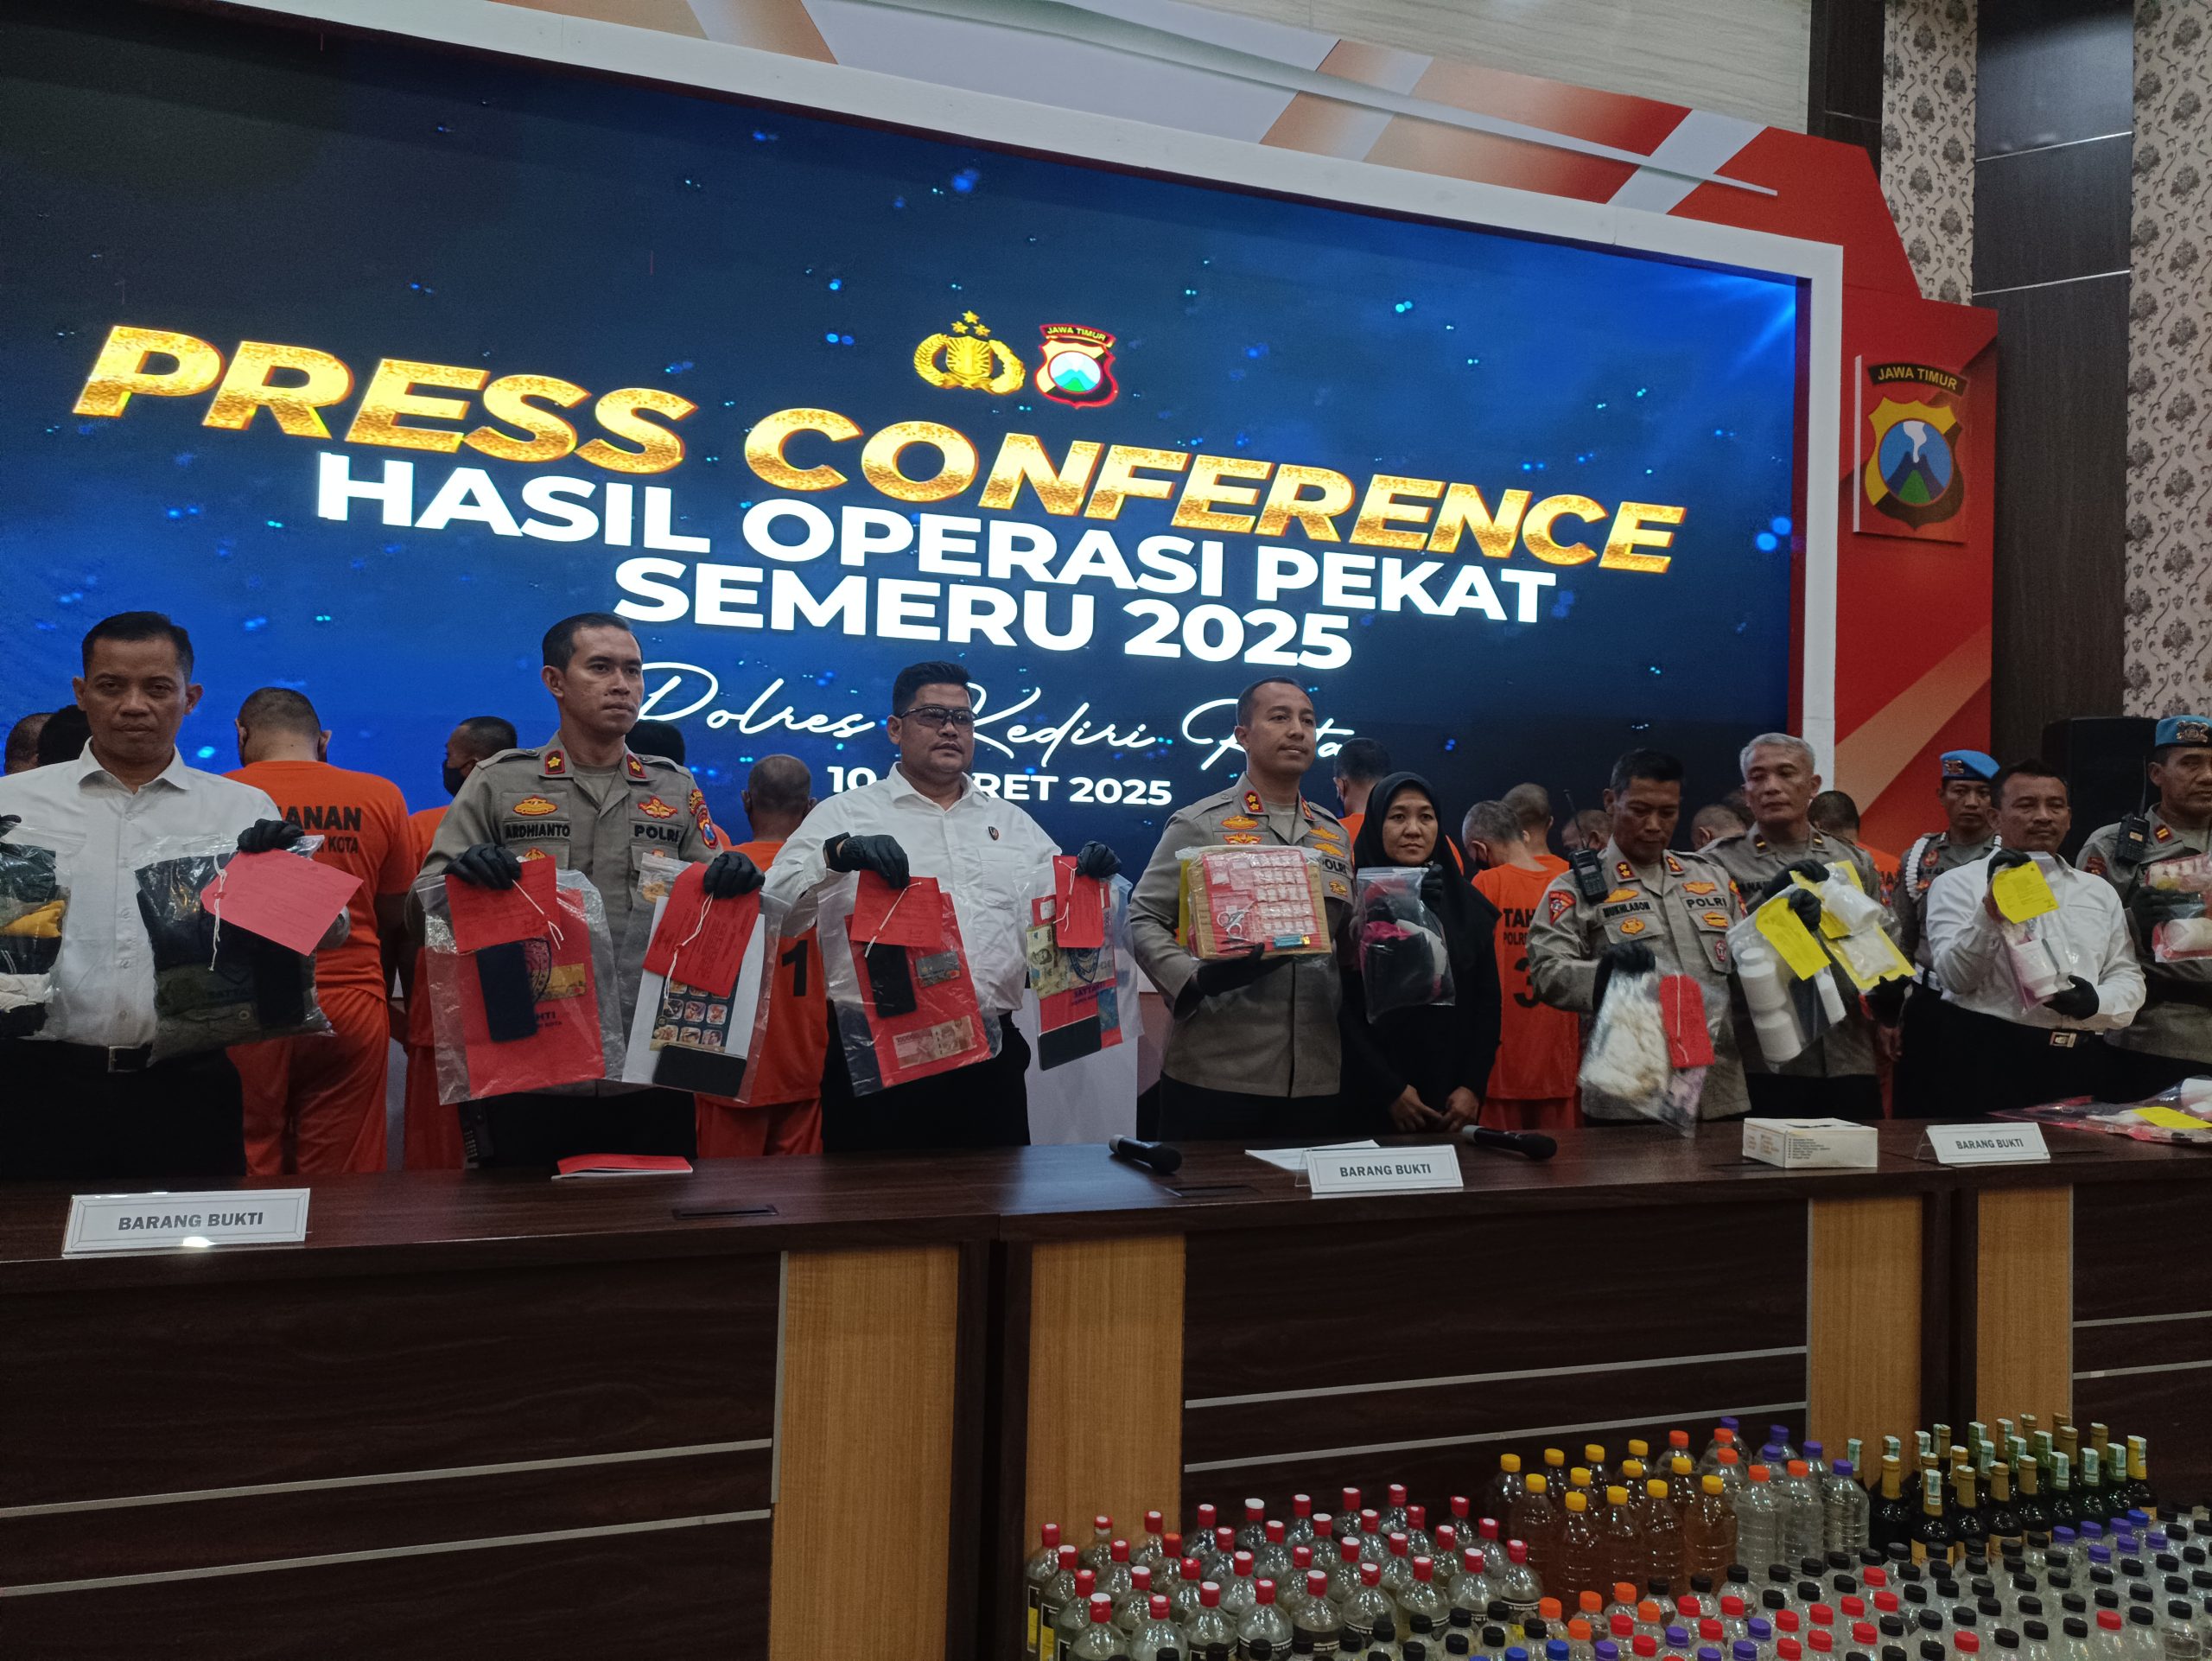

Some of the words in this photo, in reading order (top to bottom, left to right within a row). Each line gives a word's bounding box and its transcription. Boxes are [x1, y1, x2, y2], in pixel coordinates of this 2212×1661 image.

[1076, 328, 1106, 341] TIMUR
[1878, 366, 1914, 380] JAWA
[1917, 368, 1957, 391] TIMUR
[73, 324, 698, 474] PRESS
[745, 407, 1687, 574] CONFERENCE
[317, 452, 710, 553] HASIL
[741, 498, 1224, 598] OPERASI
[1256, 544, 1556, 623] PEKAT
[613, 556, 1094, 652] SEMERU
[1123, 598, 1352, 670] 2025
[828, 766, 877, 793] 10
[972, 773, 1059, 801] RET
[1069, 777, 1173, 805] 2025
[277, 805, 361, 832] ANAN
[505, 823, 571, 839] ARDHIANTO
[634, 824, 679, 842] POLRI
[328, 836, 359, 853] KOTA
[1321, 858, 1347, 875] OLRI
[1686, 898, 1727, 908] POLRI
[781, 939, 808, 996] 1
[1955, 1140, 1995, 1149] BARANG
[1996, 1138, 2024, 1149] BUKTI
[1339, 1165, 1392, 1177] BARANG
[1395, 1163, 1431, 1174] BUKTI
[118, 1214, 201, 1231] BARANG
[207, 1212, 264, 1226] BUKTI
